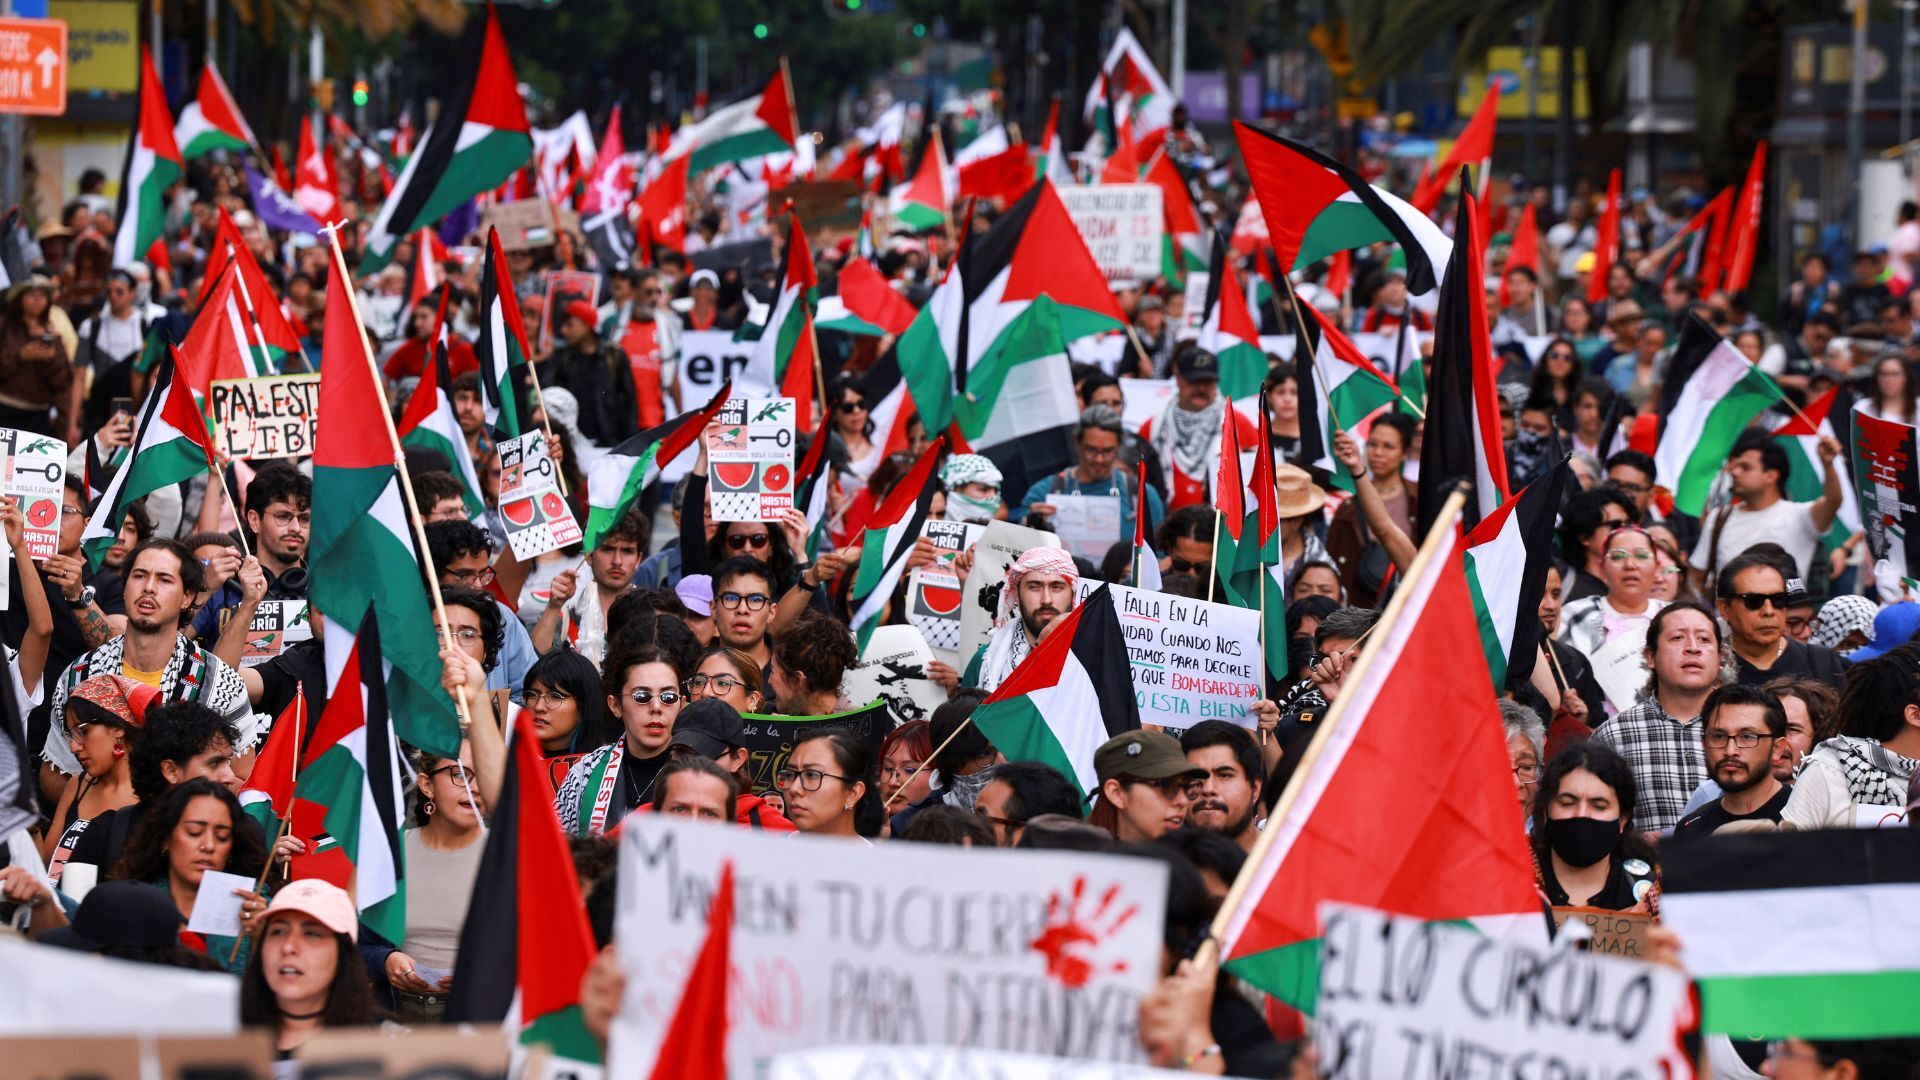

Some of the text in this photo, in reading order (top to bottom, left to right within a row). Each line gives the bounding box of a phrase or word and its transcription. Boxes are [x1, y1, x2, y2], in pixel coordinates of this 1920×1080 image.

[500, 440, 522, 456] DESDE
[761, 496, 791, 507] HASTA
[23, 531, 56, 544] HASTA
[929, 521, 964, 535] DESDE
[938, 535, 960, 550] RÍO
[1124, 591, 1161, 618] FALLA
[1169, 599, 1187, 623] EN
[1193, 604, 1208, 627] LA
[256, 615, 277, 631] RÍO
[1160, 627, 1211, 651] CUANDO
[1216, 635, 1242, 657] NOS
[1170, 653, 1200, 670] PARA
[1205, 658, 1251, 679] DECIRLE
[1141, 669, 1166, 686] QUE
[1171, 673, 1259, 697] BOMBARDEAR
[1151, 692, 1190, 714] ESTA
[1200, 700, 1247, 718] BIEN
[743, 725, 758, 736] de
[767, 724, 781, 737] la
[815, 881, 886, 952] TU
[891, 886, 1047, 958] CUERP
[1586, 912, 1632, 935] RÍO
[1590, 937, 1641, 957] MAR
